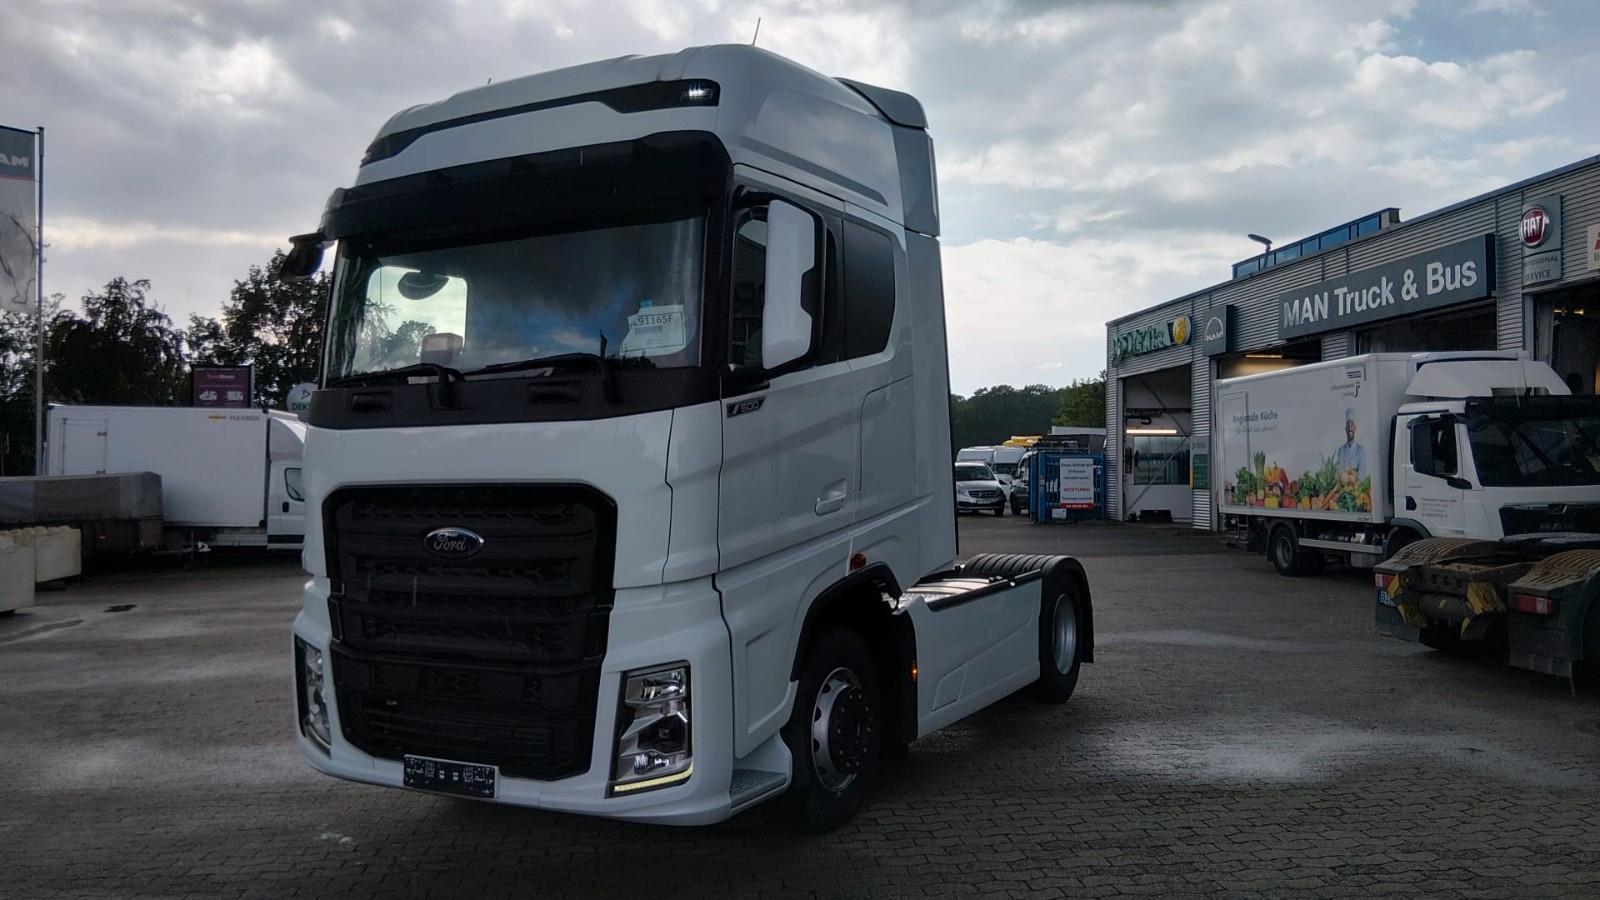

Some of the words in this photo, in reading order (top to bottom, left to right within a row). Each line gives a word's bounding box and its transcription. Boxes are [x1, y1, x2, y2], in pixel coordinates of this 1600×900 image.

[1523, 215, 1542, 238] FIAT
[1283, 292, 1328, 328] MAN
[1334, 276, 1395, 316] Truck
[1401, 269, 1418, 301] &
[1426, 261, 1478, 295] Bus
[292, 402, 310, 411] DEK
